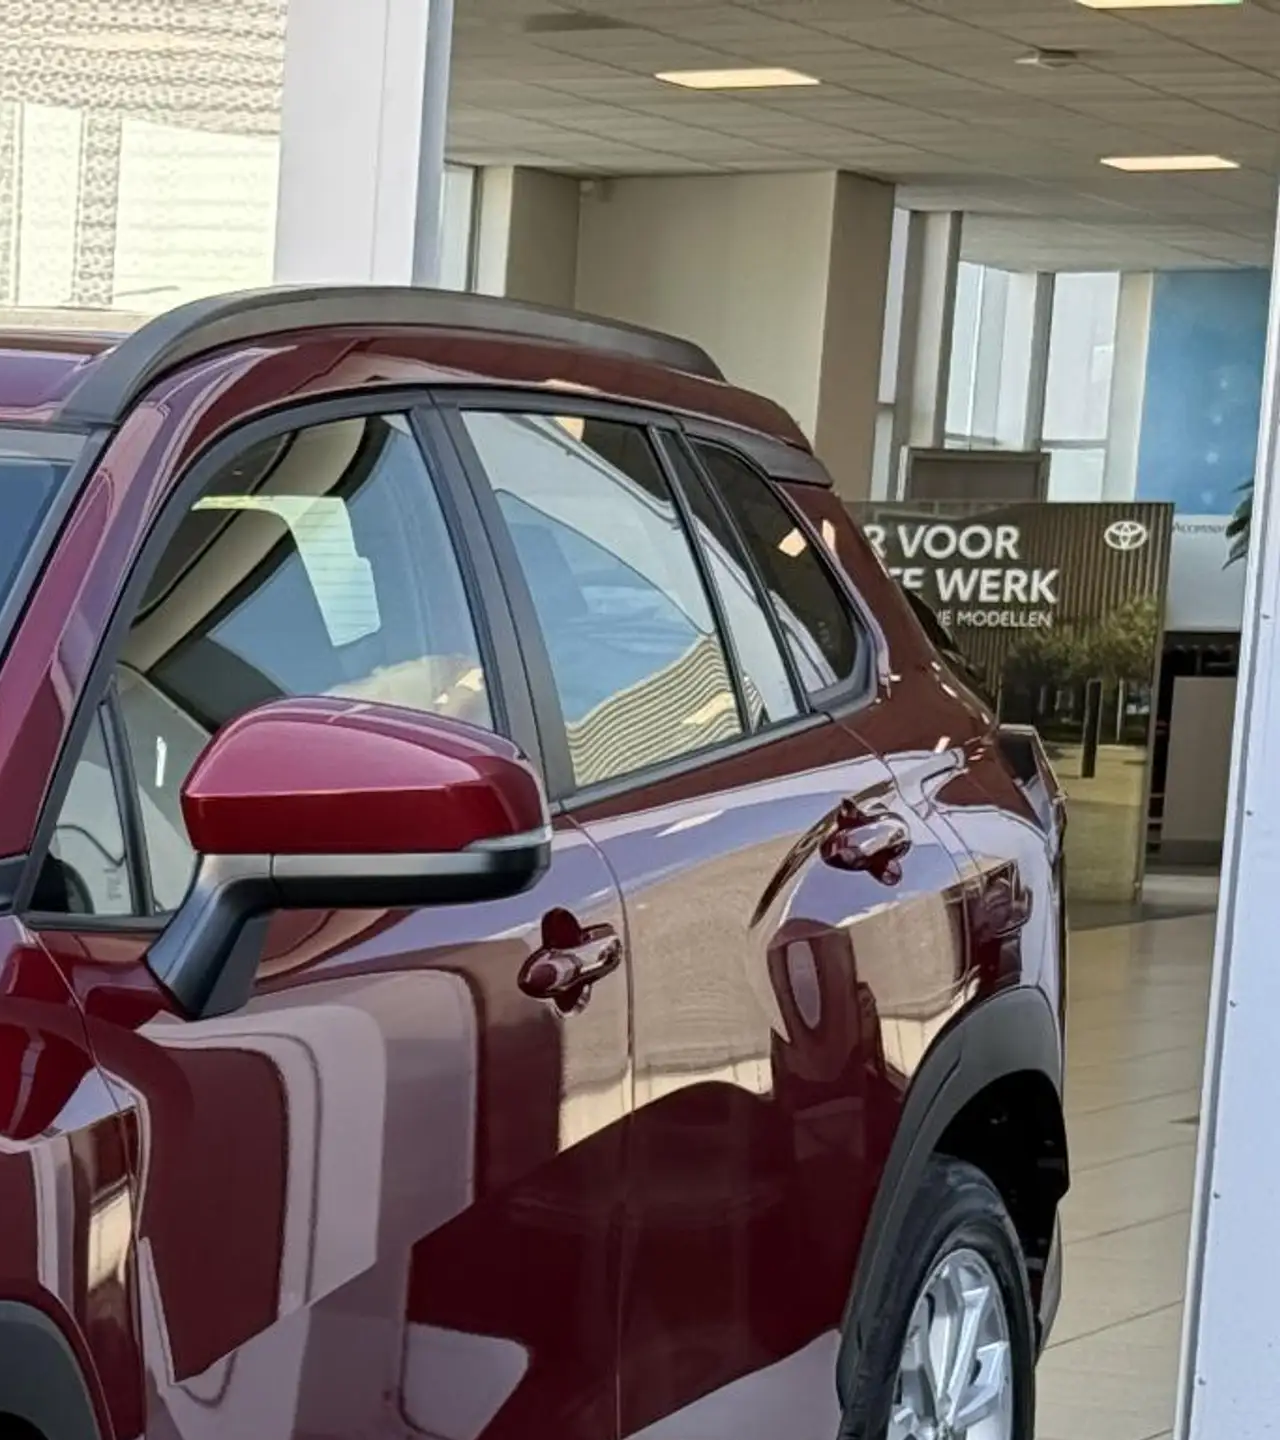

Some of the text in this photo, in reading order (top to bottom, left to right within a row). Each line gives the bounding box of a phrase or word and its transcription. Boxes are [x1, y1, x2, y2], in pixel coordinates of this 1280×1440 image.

[897, 523, 1022, 561] VOOR
[934, 567, 1060, 605] WERK
[955, 609, 1054, 629] MODELLEN
